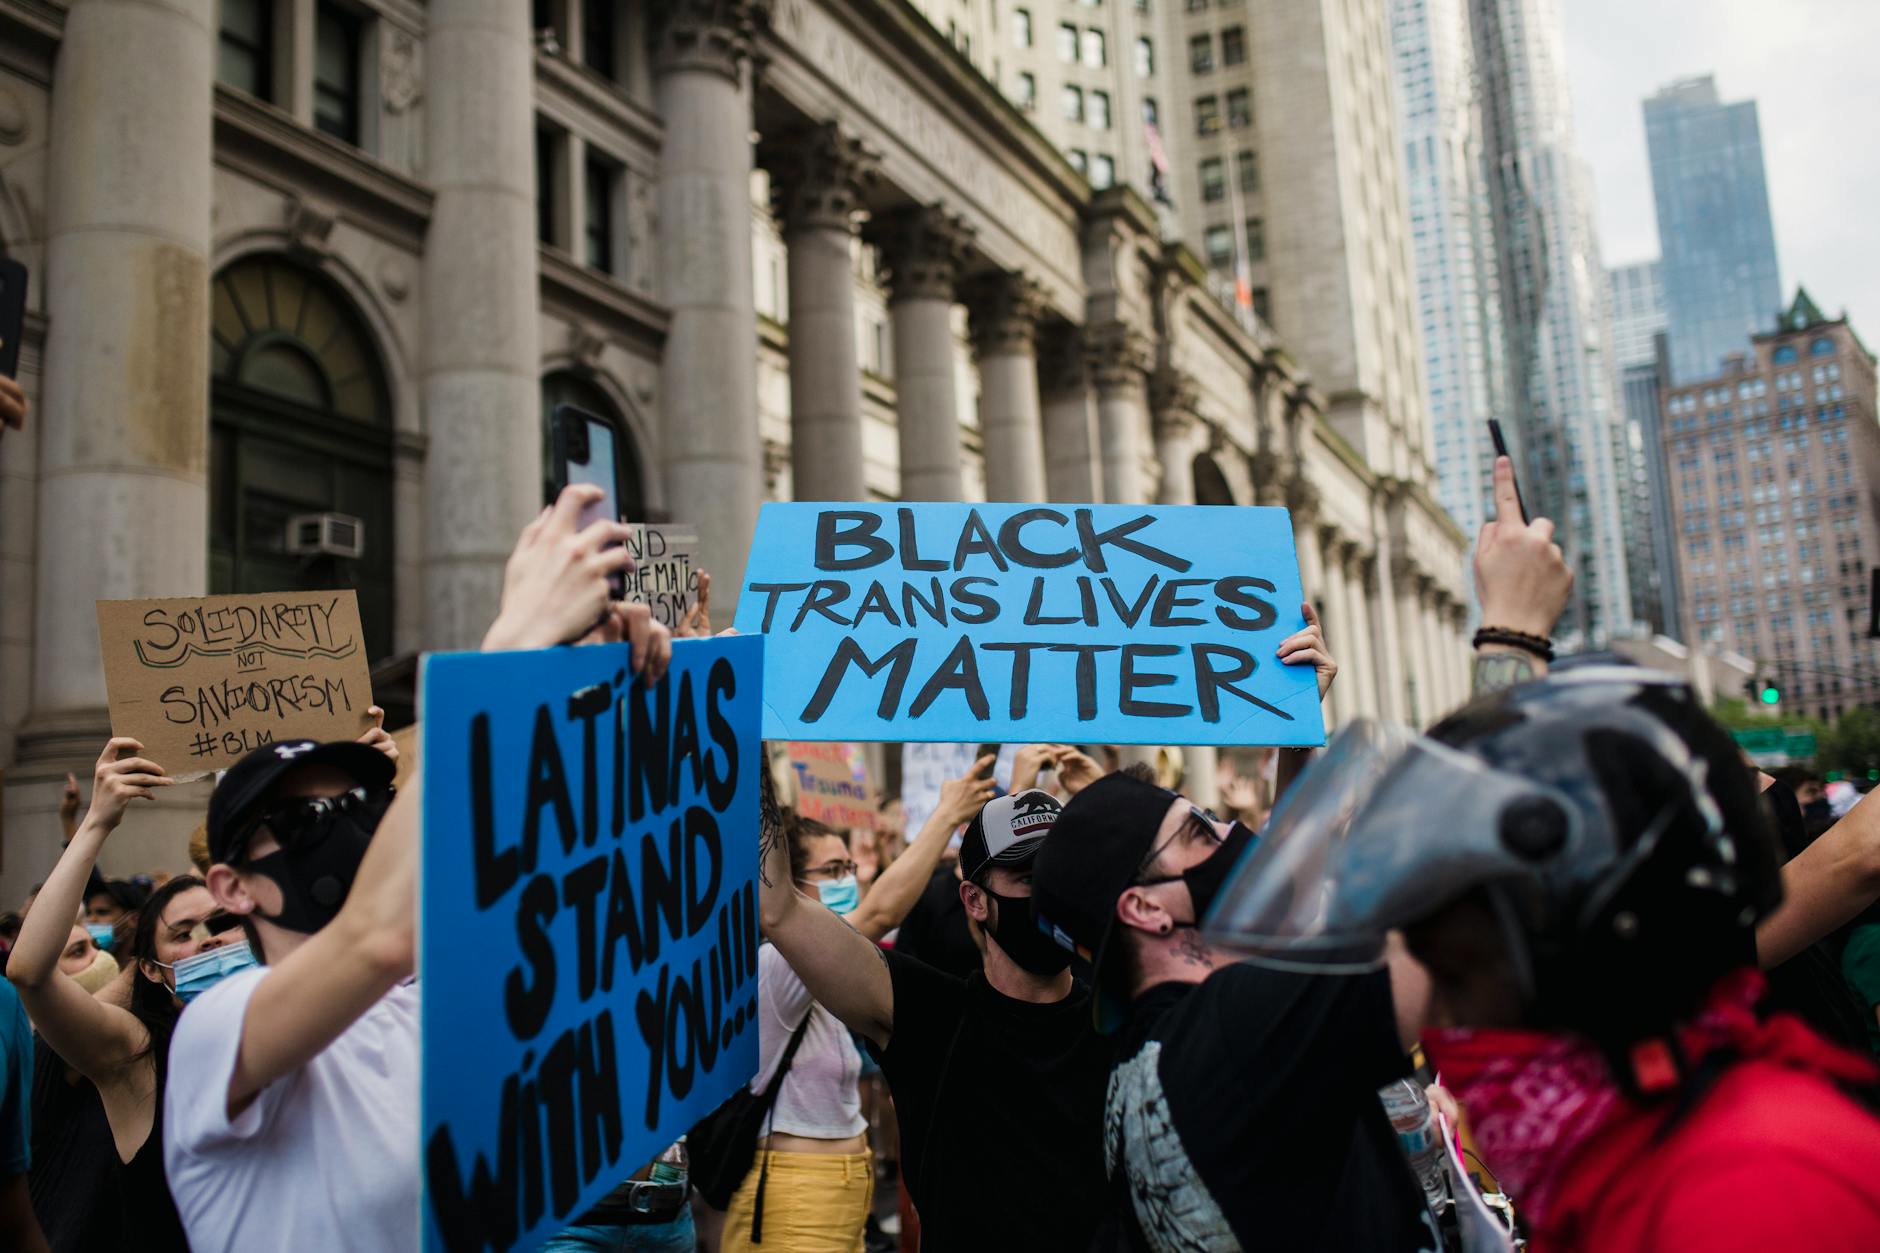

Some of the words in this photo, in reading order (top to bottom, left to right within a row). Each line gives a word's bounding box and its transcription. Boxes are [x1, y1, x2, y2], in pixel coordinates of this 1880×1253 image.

[625, 529, 666, 559] ND
[815, 508, 1193, 573] BLACK
[143, 598, 338, 650] SOLIDARITY
[748, 576, 1000, 633] TRANS
[1023, 574, 1278, 631] LIVES
[237, 651, 265, 667] NOT
[800, 634, 1295, 722] MATTER
[160, 675, 351, 728] SAVIORISM
[1010, 813, 1057, 829] CALIFORNI
[505, 806, 722, 1042] STAND
[635, 880, 756, 1132] YOU!!!
